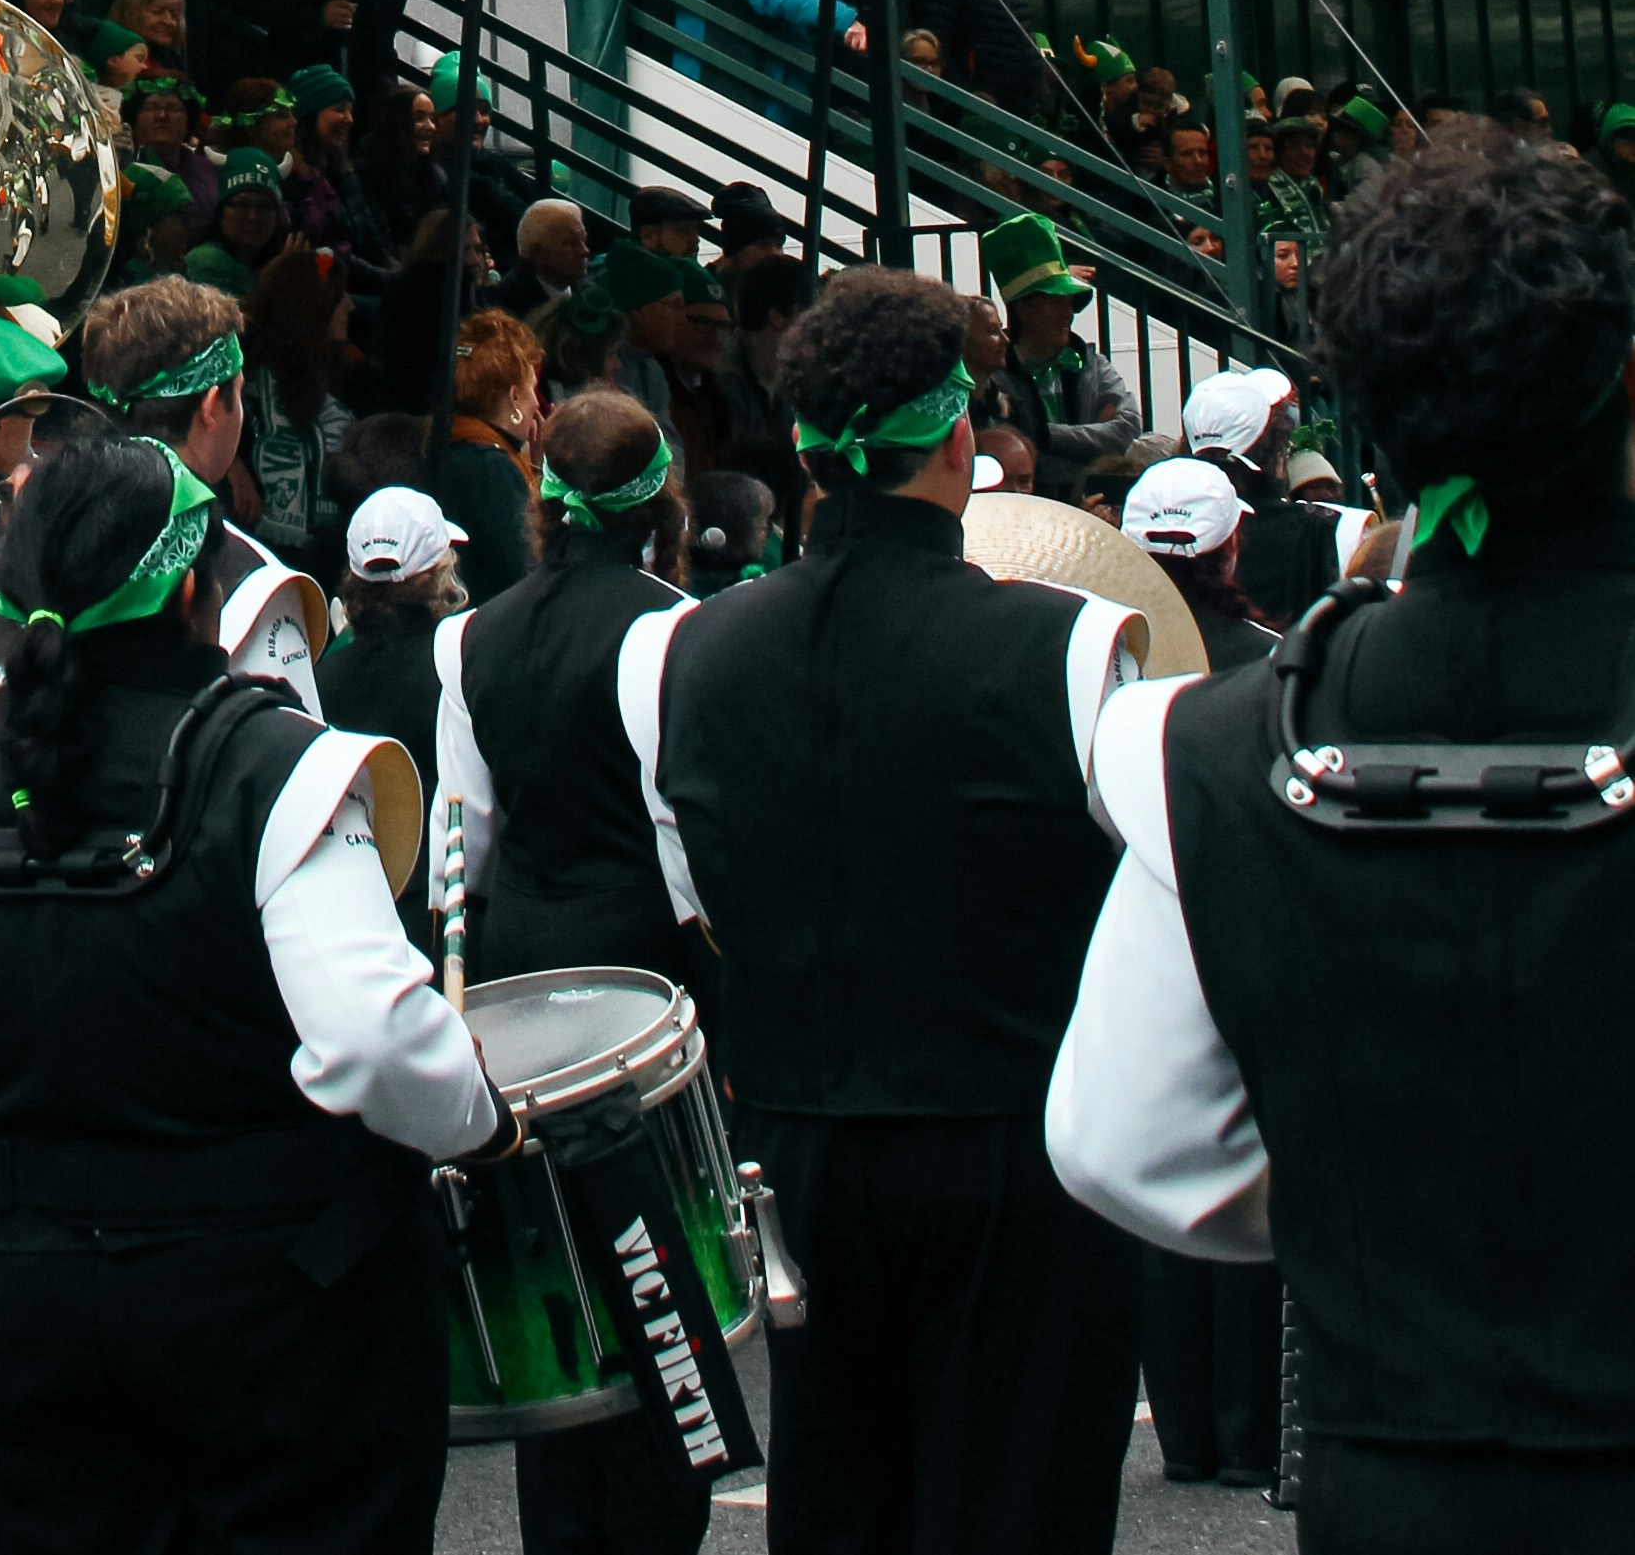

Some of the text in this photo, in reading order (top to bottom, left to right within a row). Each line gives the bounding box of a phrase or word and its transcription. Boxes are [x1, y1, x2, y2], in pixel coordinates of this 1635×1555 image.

[268, 618, 281, 657] BISHOP
[614, 1215, 729, 1466] VIC FIRTH
